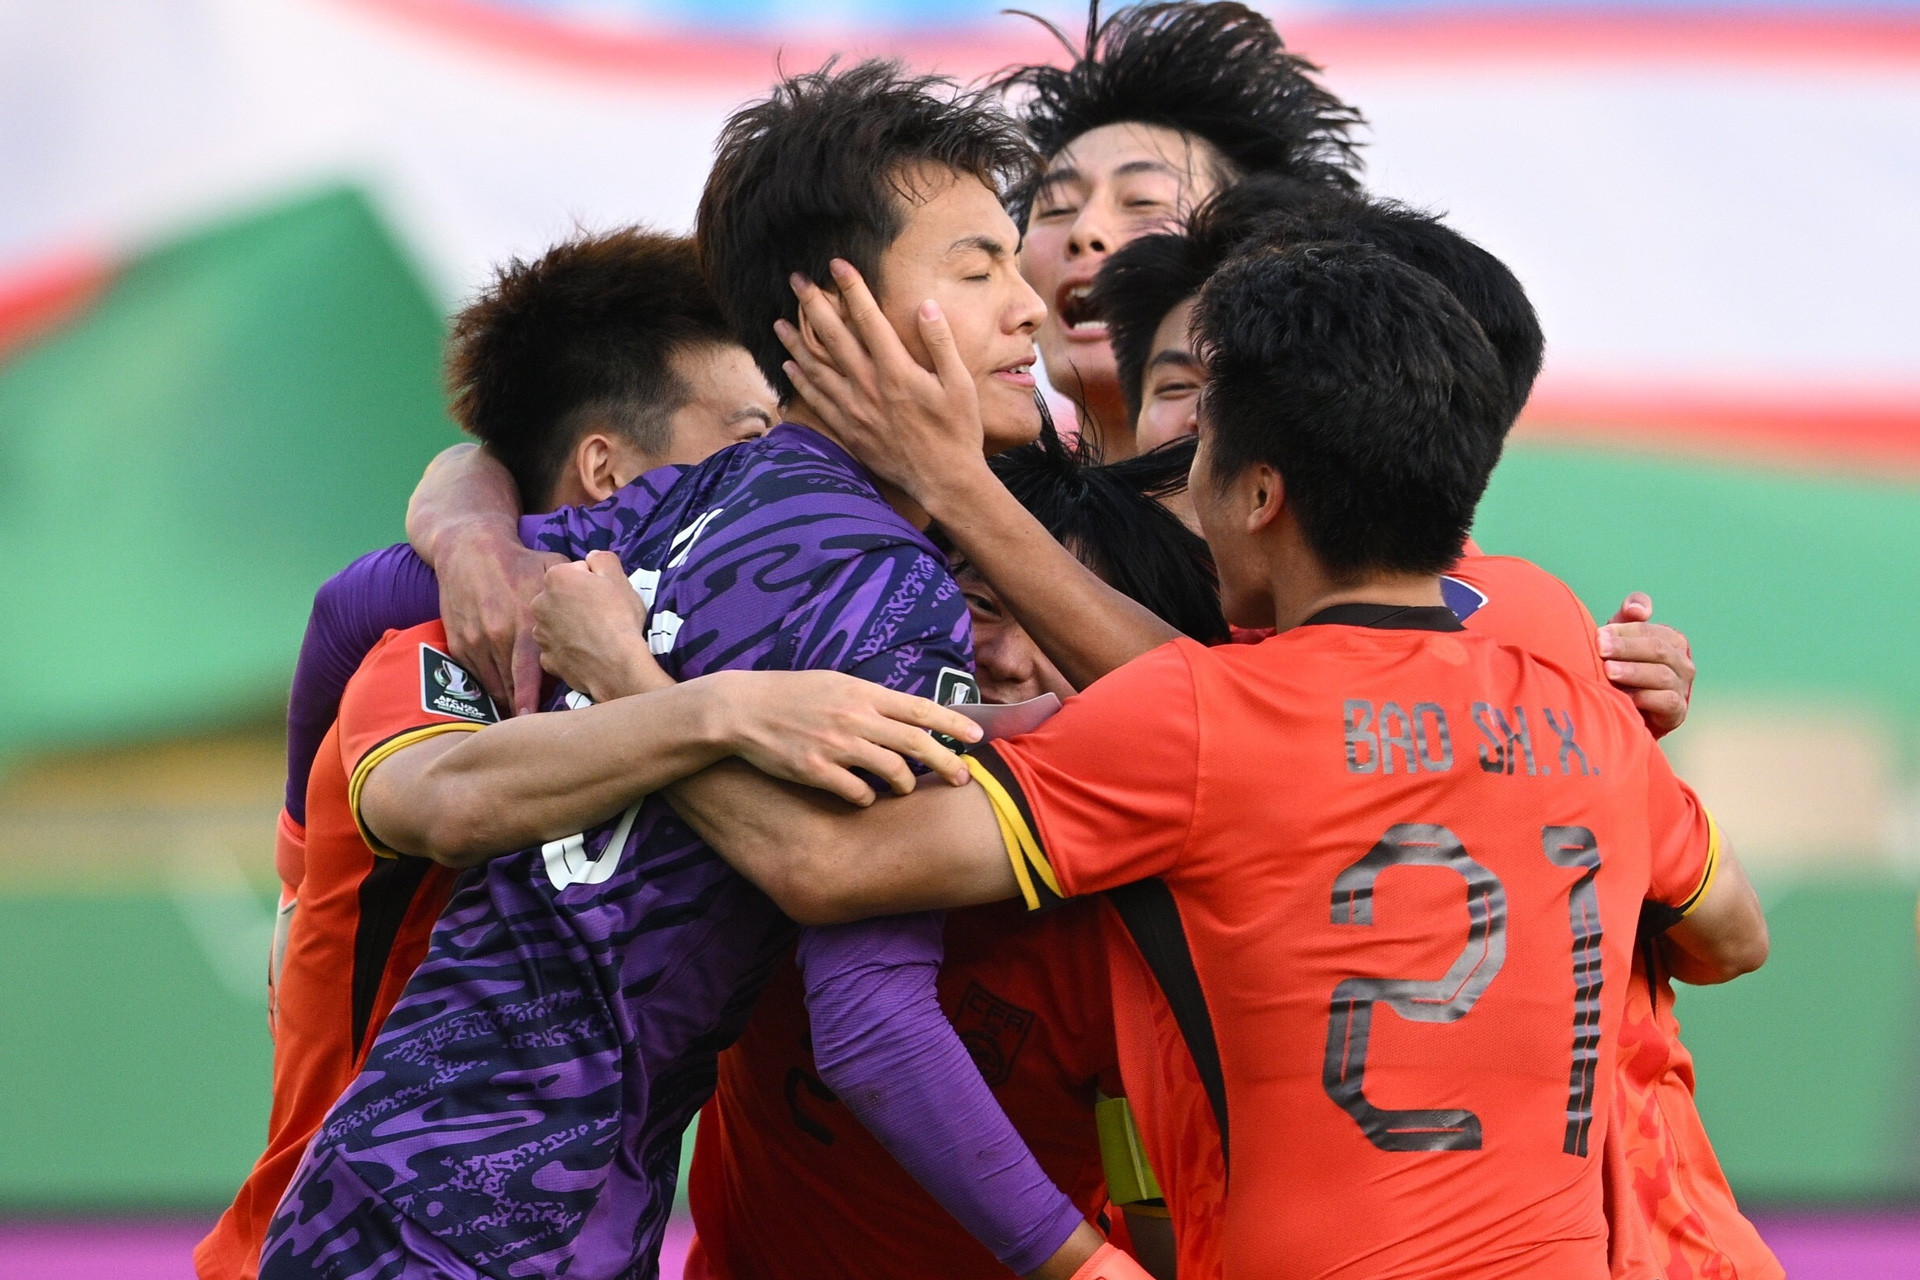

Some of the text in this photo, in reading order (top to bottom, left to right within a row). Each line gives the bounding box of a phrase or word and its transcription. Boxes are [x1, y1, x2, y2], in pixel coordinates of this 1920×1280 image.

[1343, 699, 1454, 775] BAO
[968, 993, 1025, 1032] CFA
[1322, 823, 1604, 1159] 21
